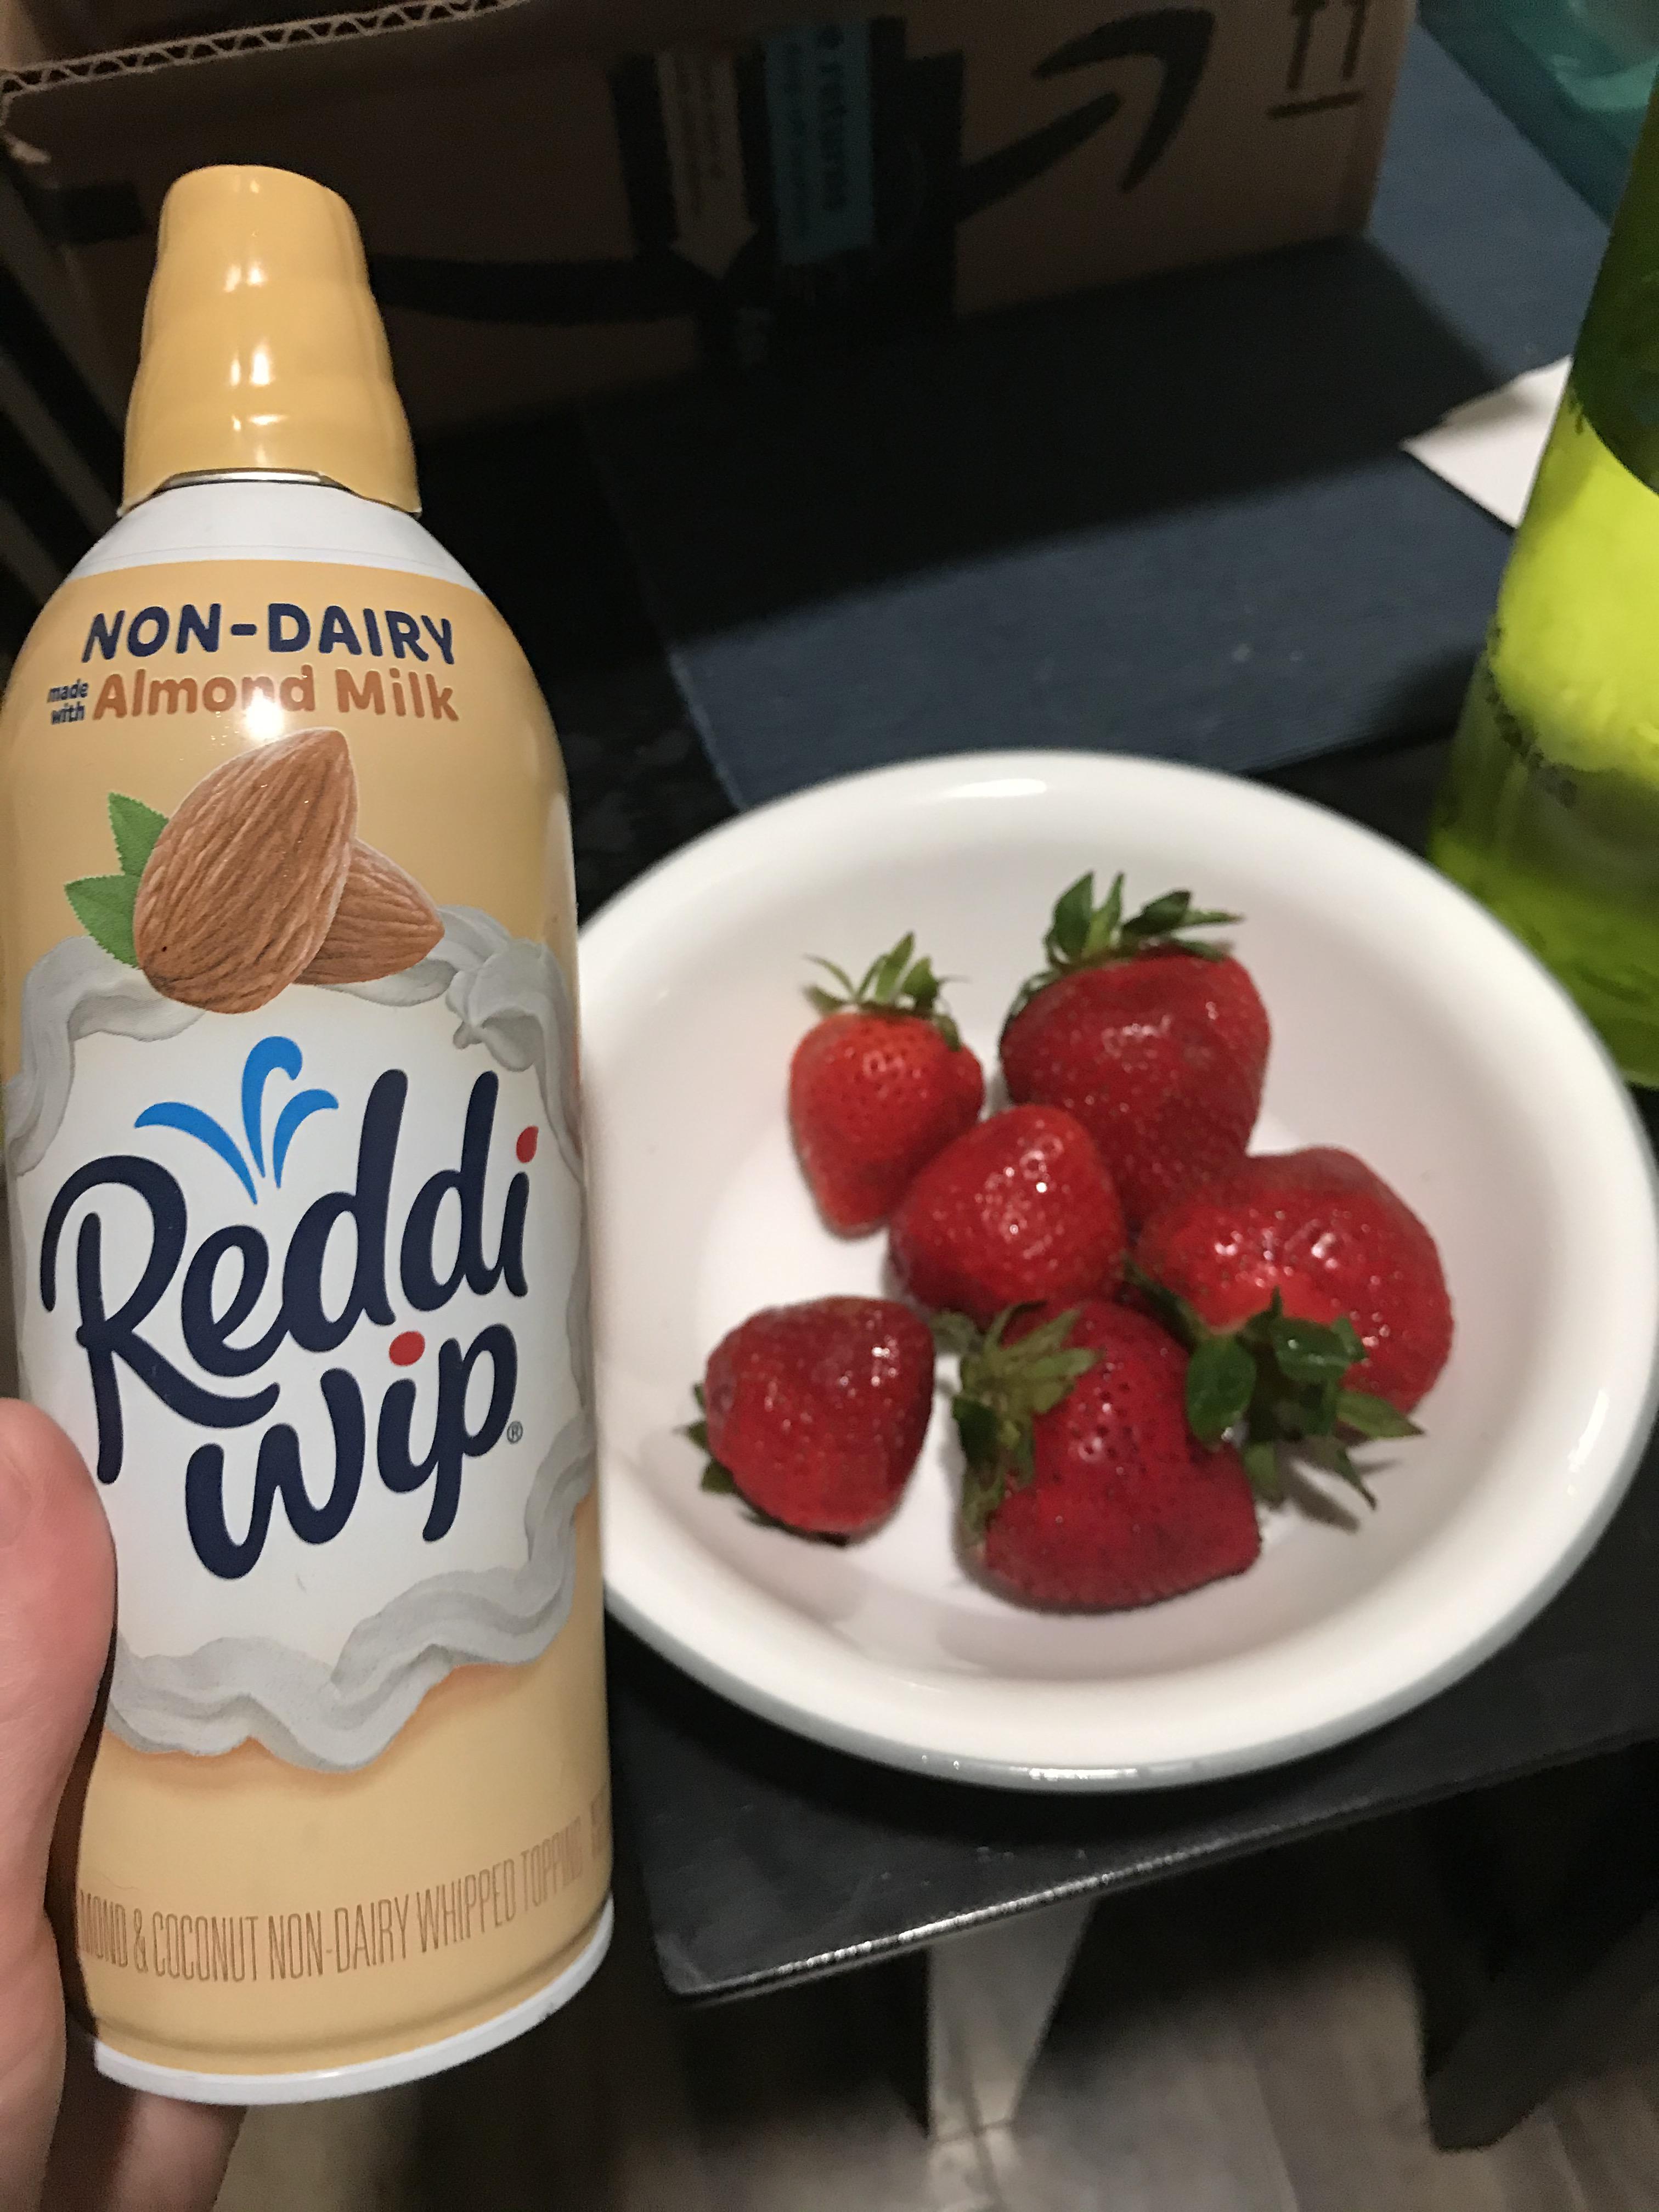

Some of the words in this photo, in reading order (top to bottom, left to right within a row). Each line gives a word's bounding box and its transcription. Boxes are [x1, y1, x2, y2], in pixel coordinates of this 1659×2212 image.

[82, 602, 455, 665] NON-DAIRY
[47, 678, 89, 703] made
[51, 701, 85, 725] with
[92, 664, 316, 721] Almond
[335, 667, 460, 722] Milk
[40, 1068, 539, 1485] Reddi
[185, 1323, 518, 1579] wip
[79, 1889, 128, 1967] MOND
[133, 1908, 148, 1973] &
[153, 1911, 259, 1982] COCONUT
[268, 1893, 410, 1980] NON-DAIRY
[416, 1858, 517, 1954] WHIPPED
